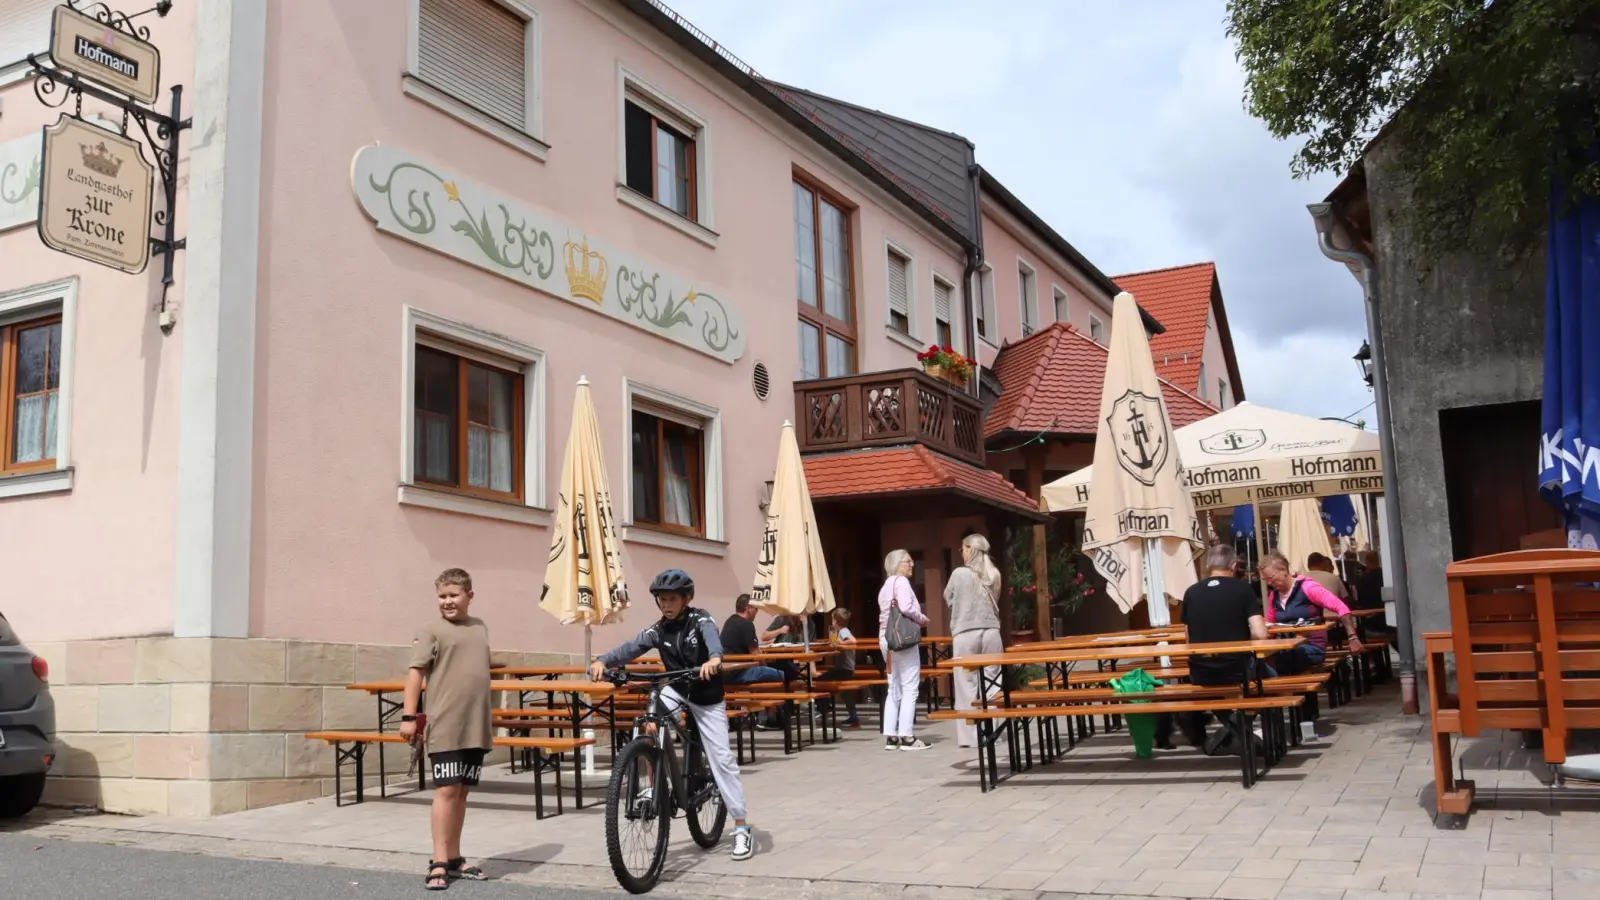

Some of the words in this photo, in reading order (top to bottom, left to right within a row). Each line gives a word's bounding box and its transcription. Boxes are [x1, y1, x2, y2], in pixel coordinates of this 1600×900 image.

[77, 38, 135, 77] Hofmann
[67, 168, 133, 203] Landgasthof
[84, 195, 113, 216] zur
[66, 208, 125, 245] Krone
[1291, 456, 1376, 477] Hofmann
